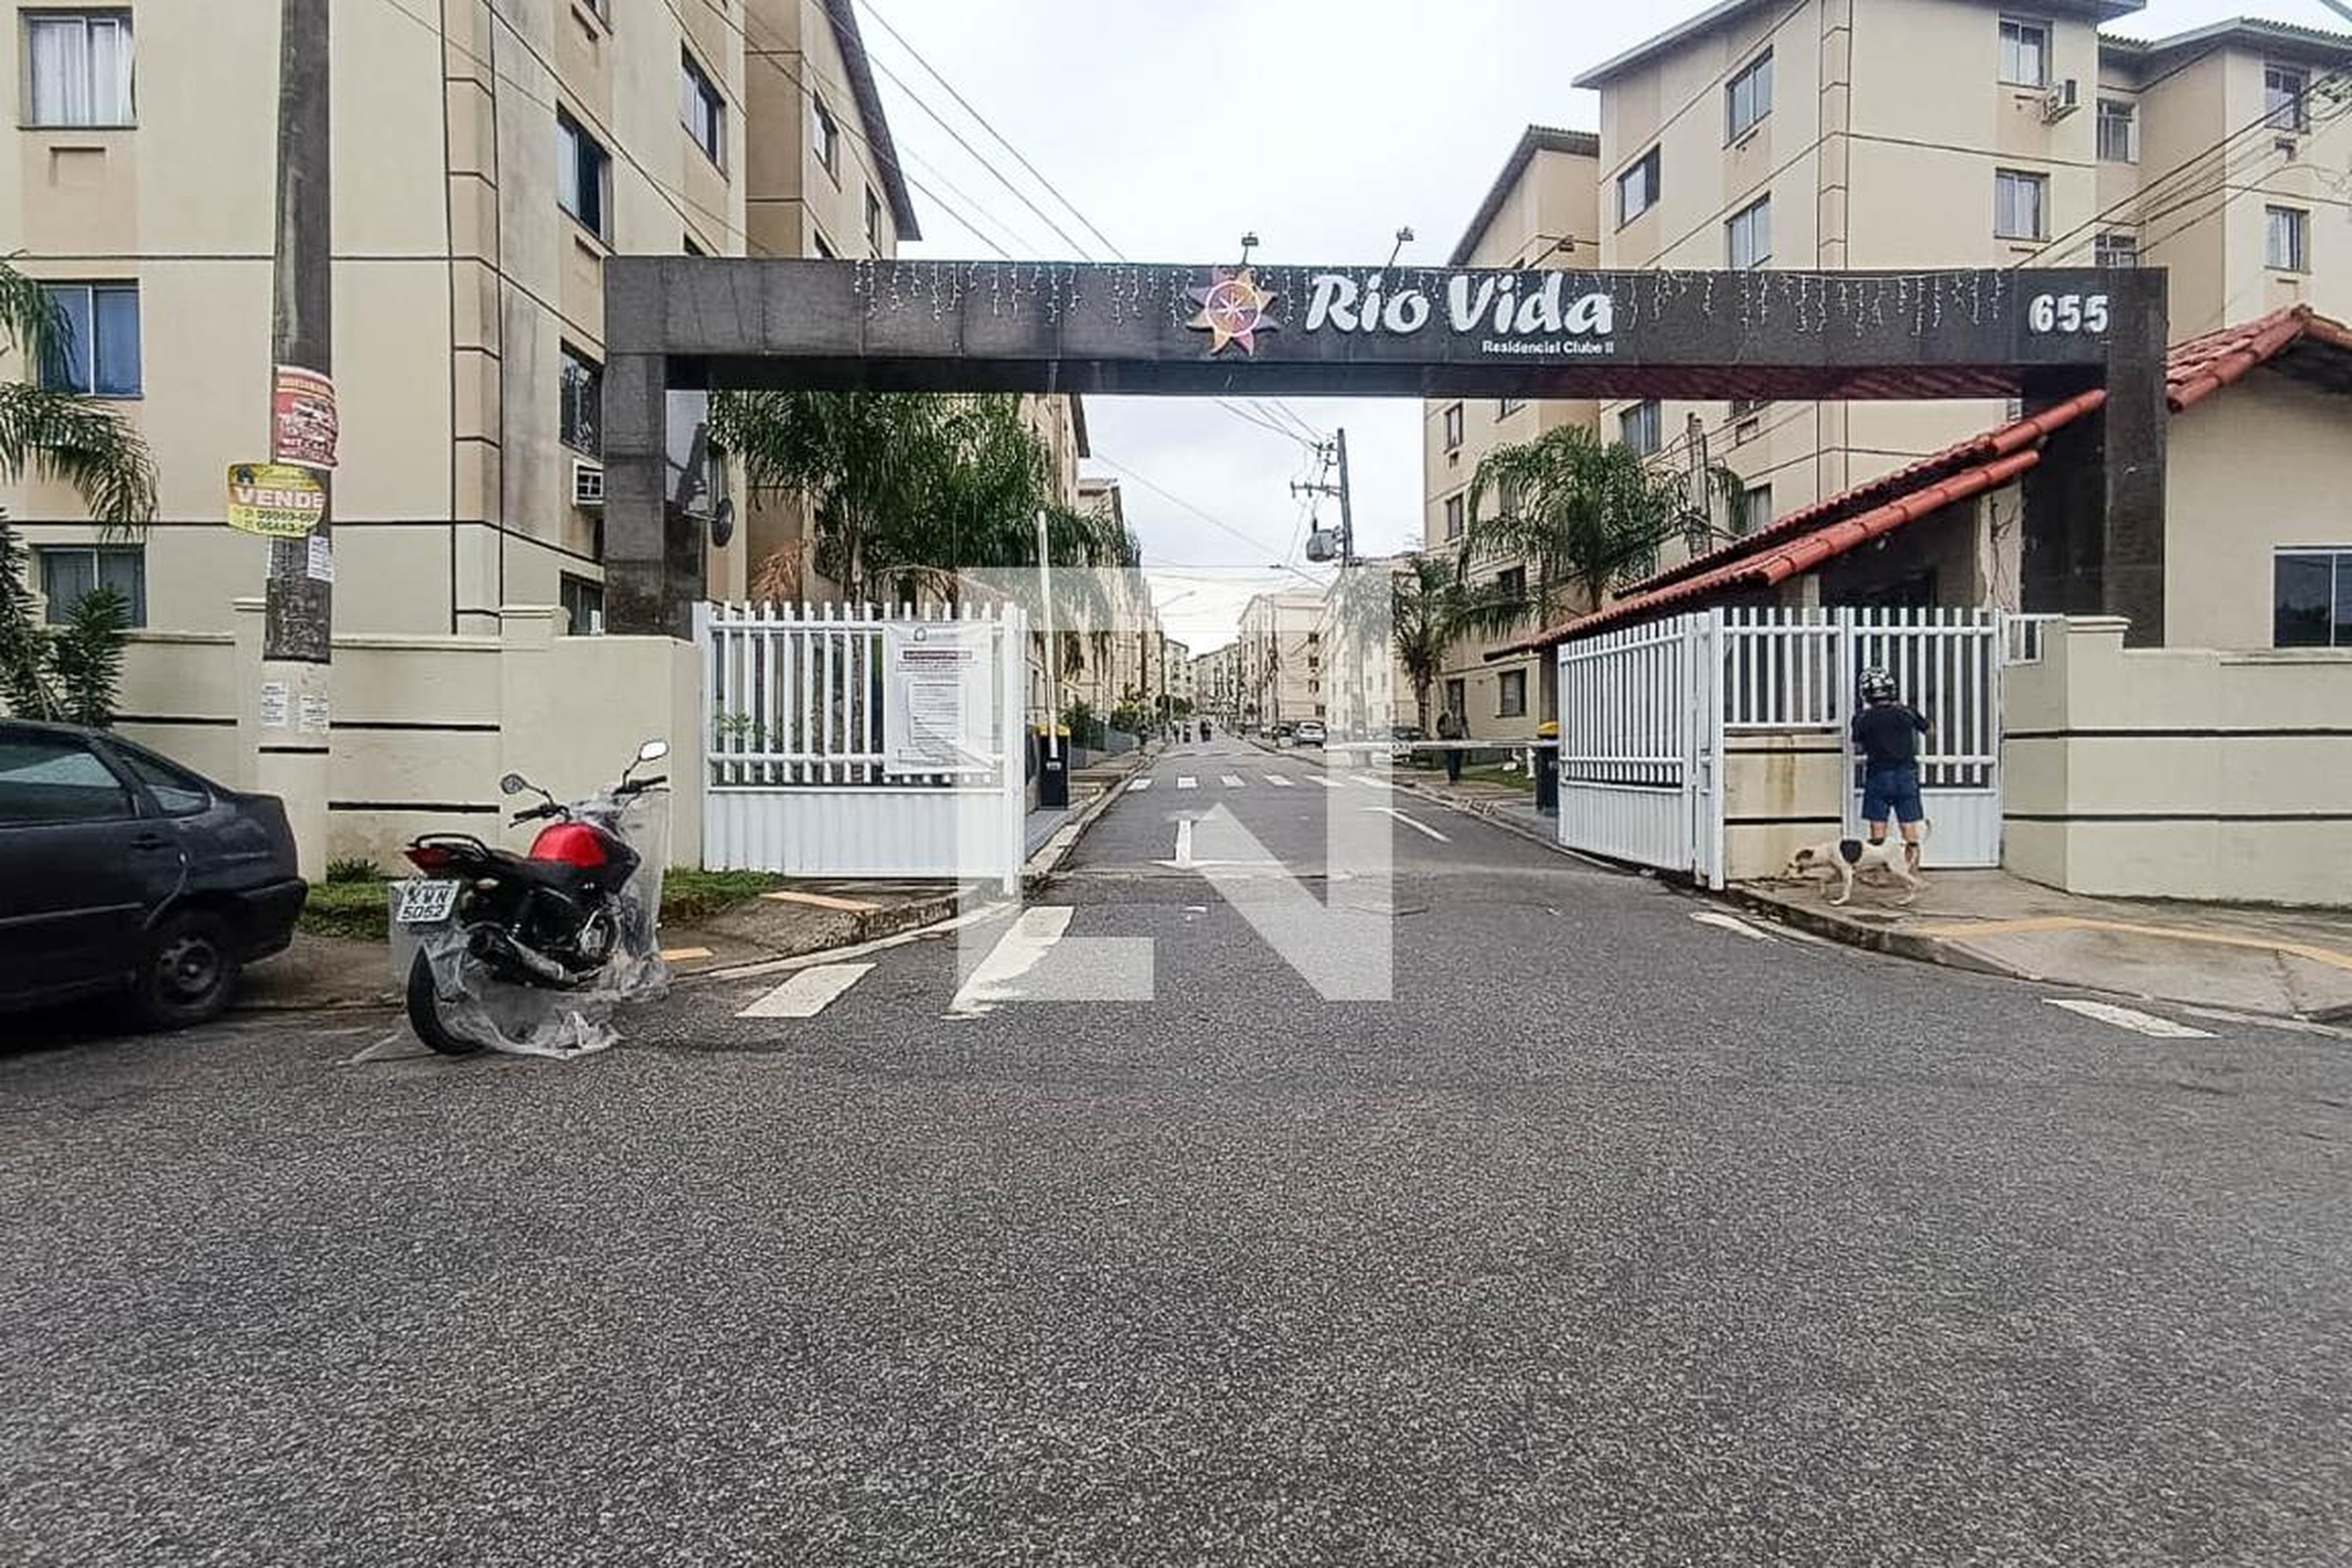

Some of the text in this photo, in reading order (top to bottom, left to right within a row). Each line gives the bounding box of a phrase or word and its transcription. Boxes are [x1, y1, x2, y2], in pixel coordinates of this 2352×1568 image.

[1306, 272, 1614, 334] Rio Vida
[2029, 293, 2108, 331] 655
[1482, 341, 1561, 353] Residencial
[1562, 341, 1602, 353] Clube
[233, 487, 326, 508] VENDE
